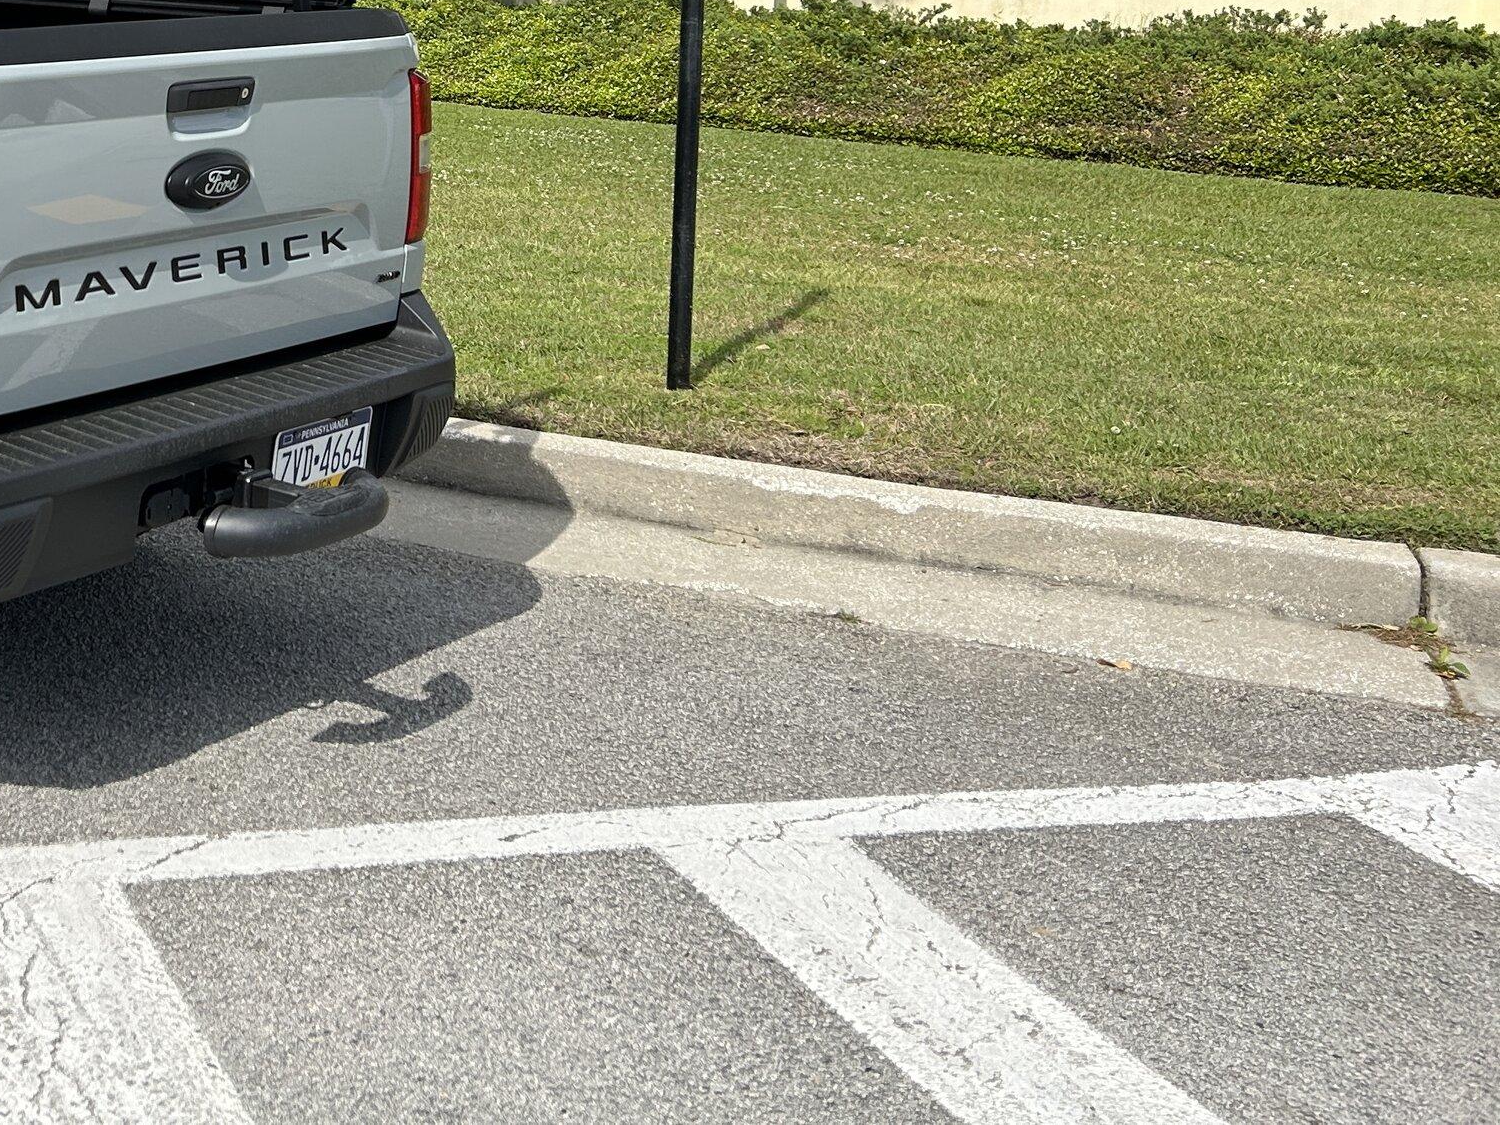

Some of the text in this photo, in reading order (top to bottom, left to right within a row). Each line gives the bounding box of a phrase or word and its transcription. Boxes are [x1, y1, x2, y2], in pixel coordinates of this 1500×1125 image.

[204, 169, 240, 195] Ford
[14, 226, 348, 313] MAVERICK
[301, 417, 349, 441] PENNSYLVANIA
